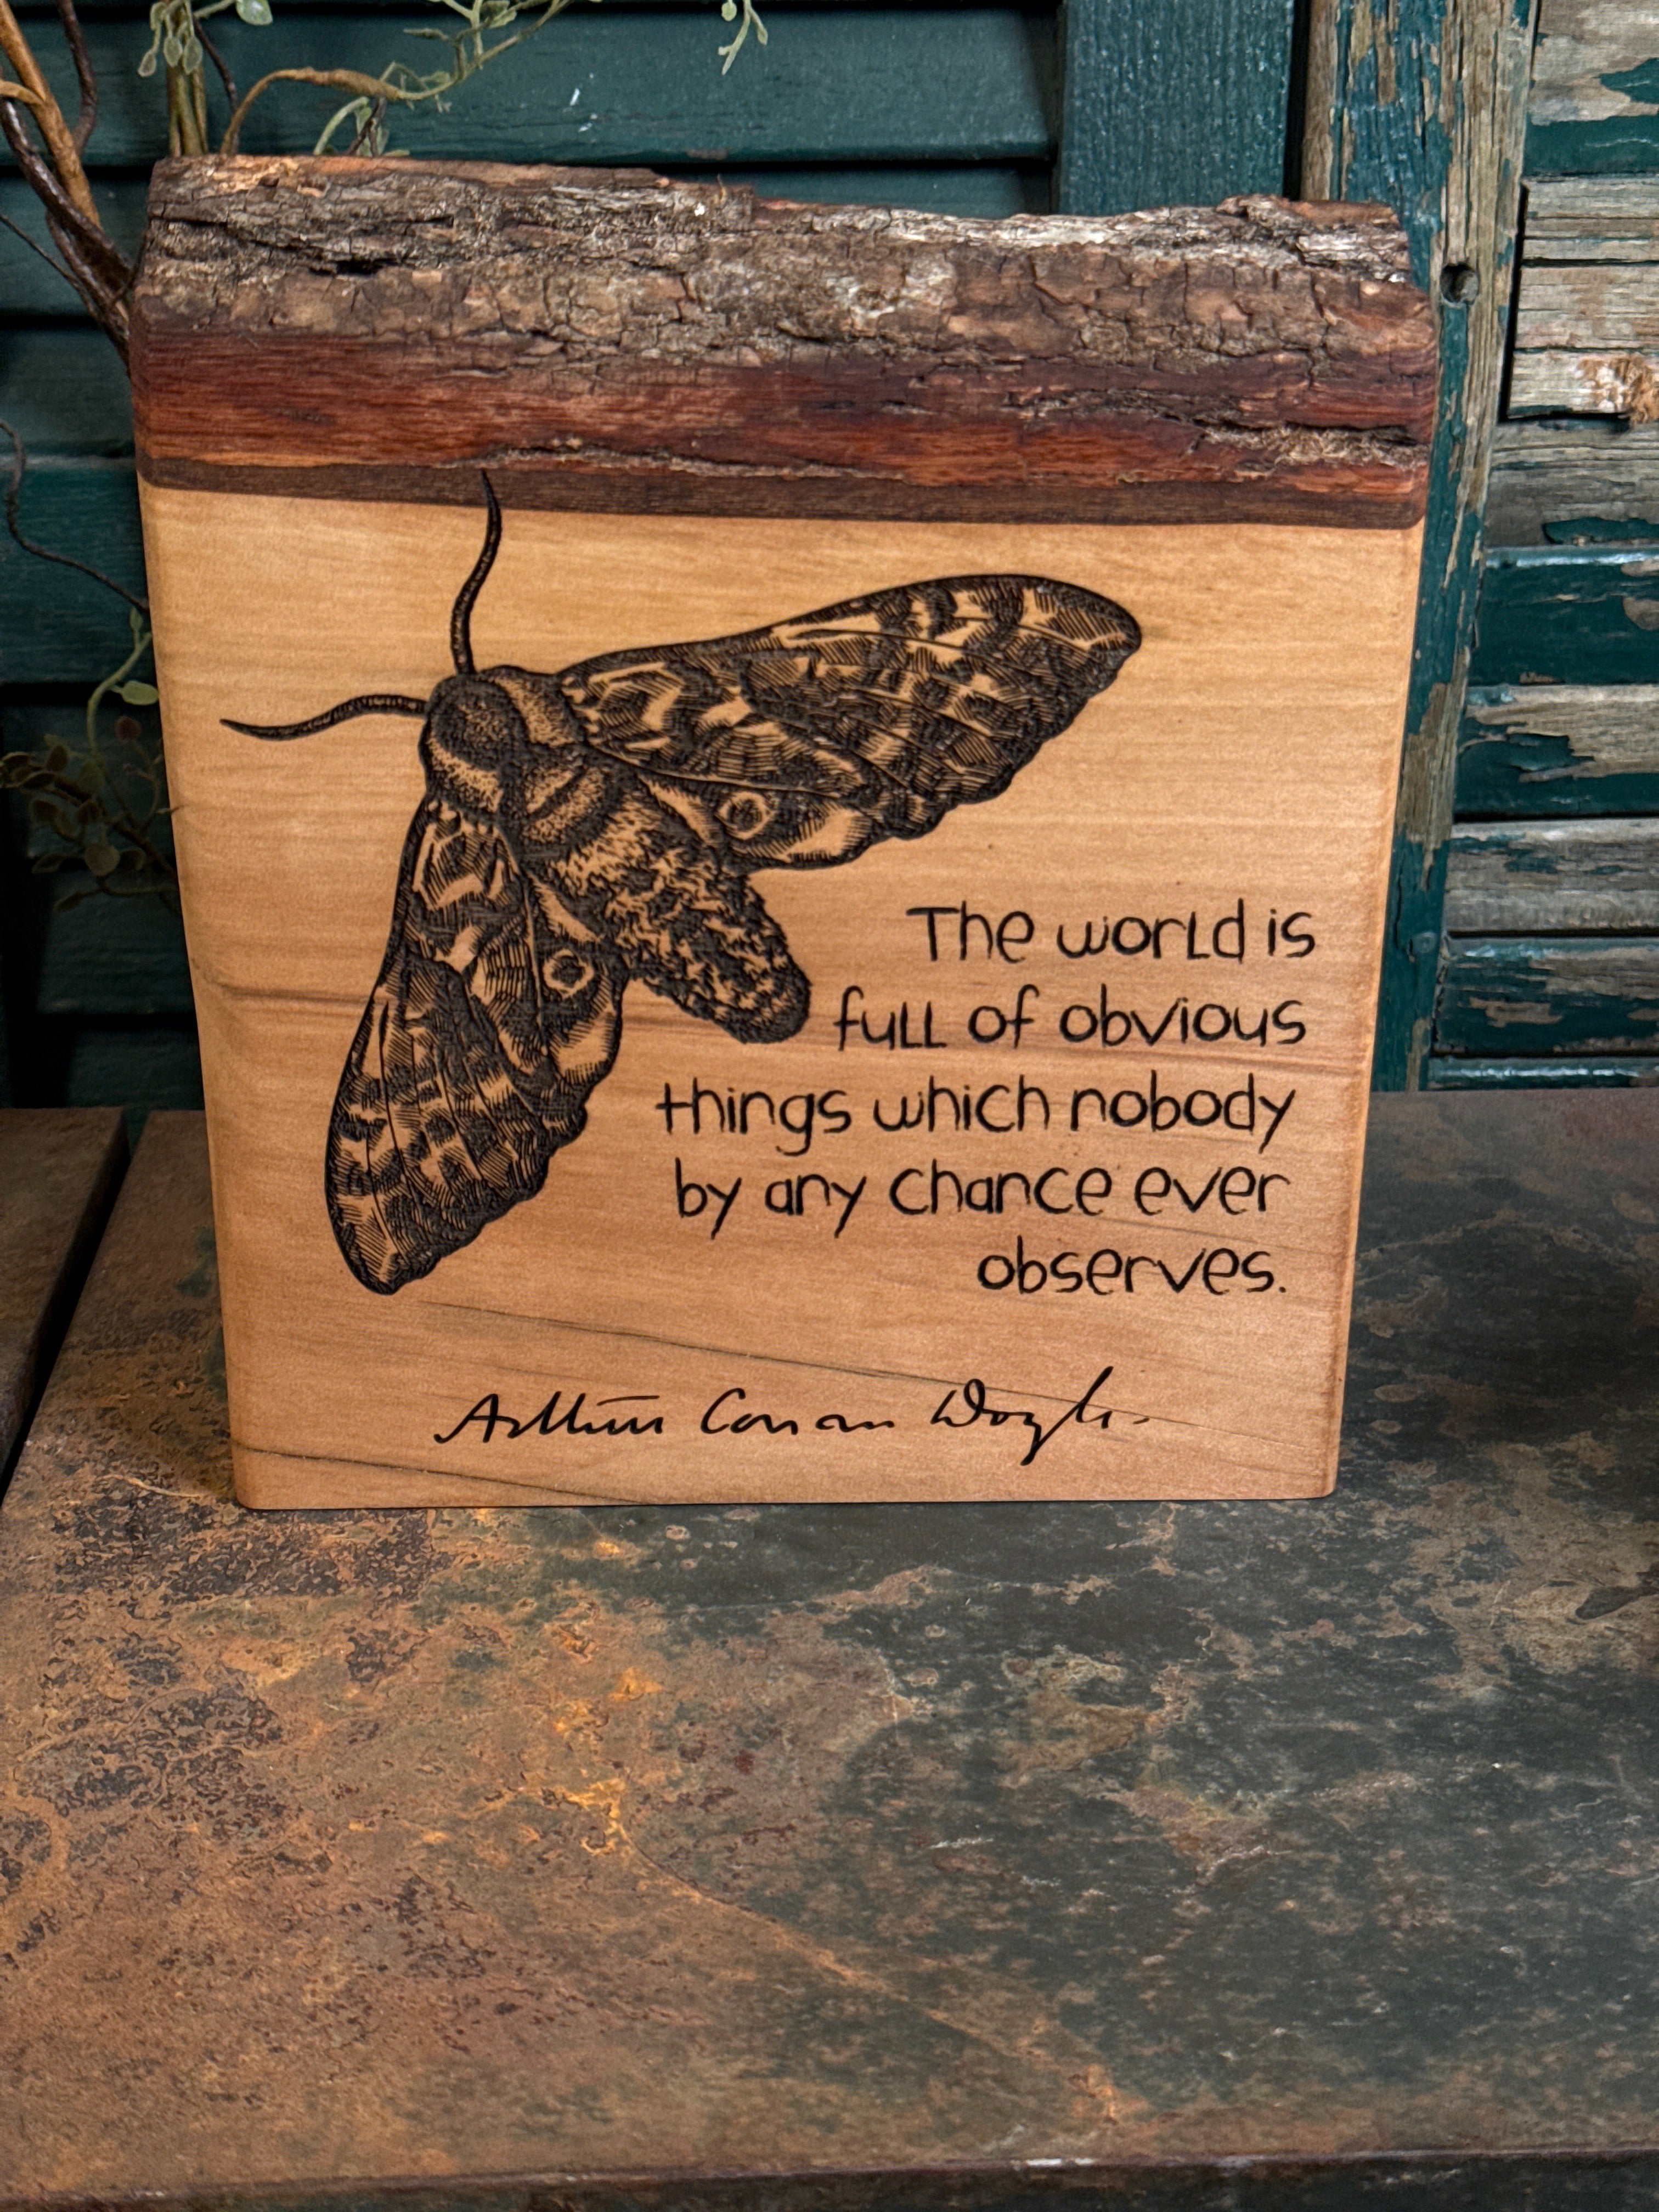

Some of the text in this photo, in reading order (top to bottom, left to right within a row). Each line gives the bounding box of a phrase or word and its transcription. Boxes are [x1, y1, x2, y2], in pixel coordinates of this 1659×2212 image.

[906, 900, 1035, 964] The
[1267, 911, 1316, 958] is
[968, 983, 1040, 1049] of
[1059, 982, 1307, 1047] obvious
[656, 1069, 1296, 1157] things which nobody
[675, 1156, 1291, 1241] by any chance ever
[977, 1234, 1287, 1296] observes.
